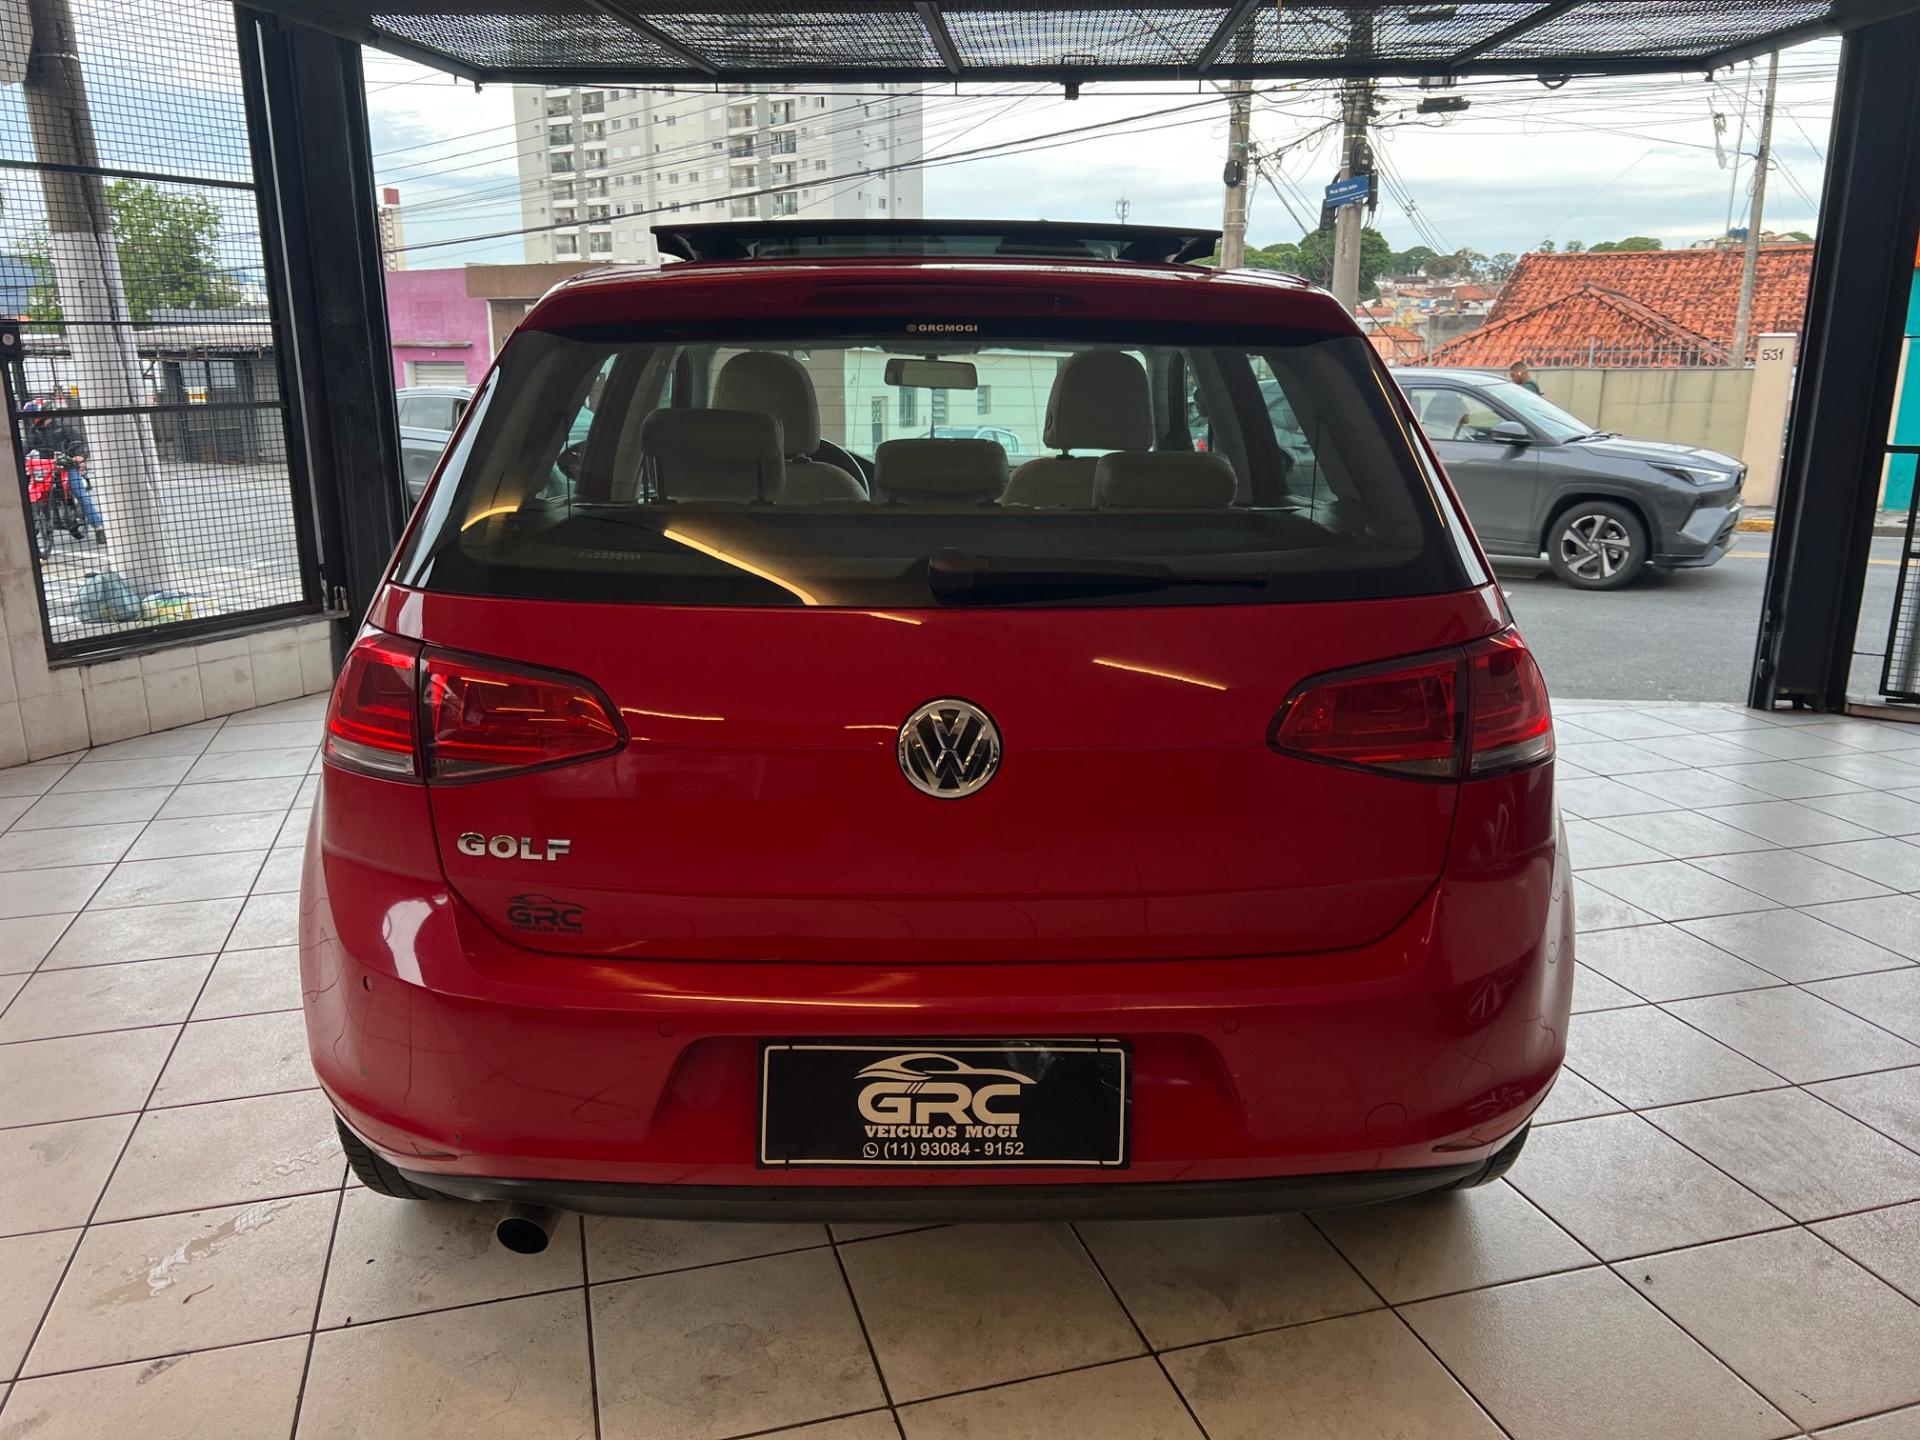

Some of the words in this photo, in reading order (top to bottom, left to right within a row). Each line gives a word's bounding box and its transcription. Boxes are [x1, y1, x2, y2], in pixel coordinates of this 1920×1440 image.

[918, 324, 978, 332] GRCMOGI
[1762, 348, 1784, 360] 531
[457, 832, 571, 861] GOLF
[507, 905, 583, 928] GRC
[857, 1082, 1020, 1124] GRC
[864, 1125, 957, 1138] VEICULOS
[965, 1125, 1018, 1138] MOGI
[884, 1142, 916, 1159] (11)
[920, 1142, 971, 1156] 93084
[984, 1142, 1024, 1156] 9152
